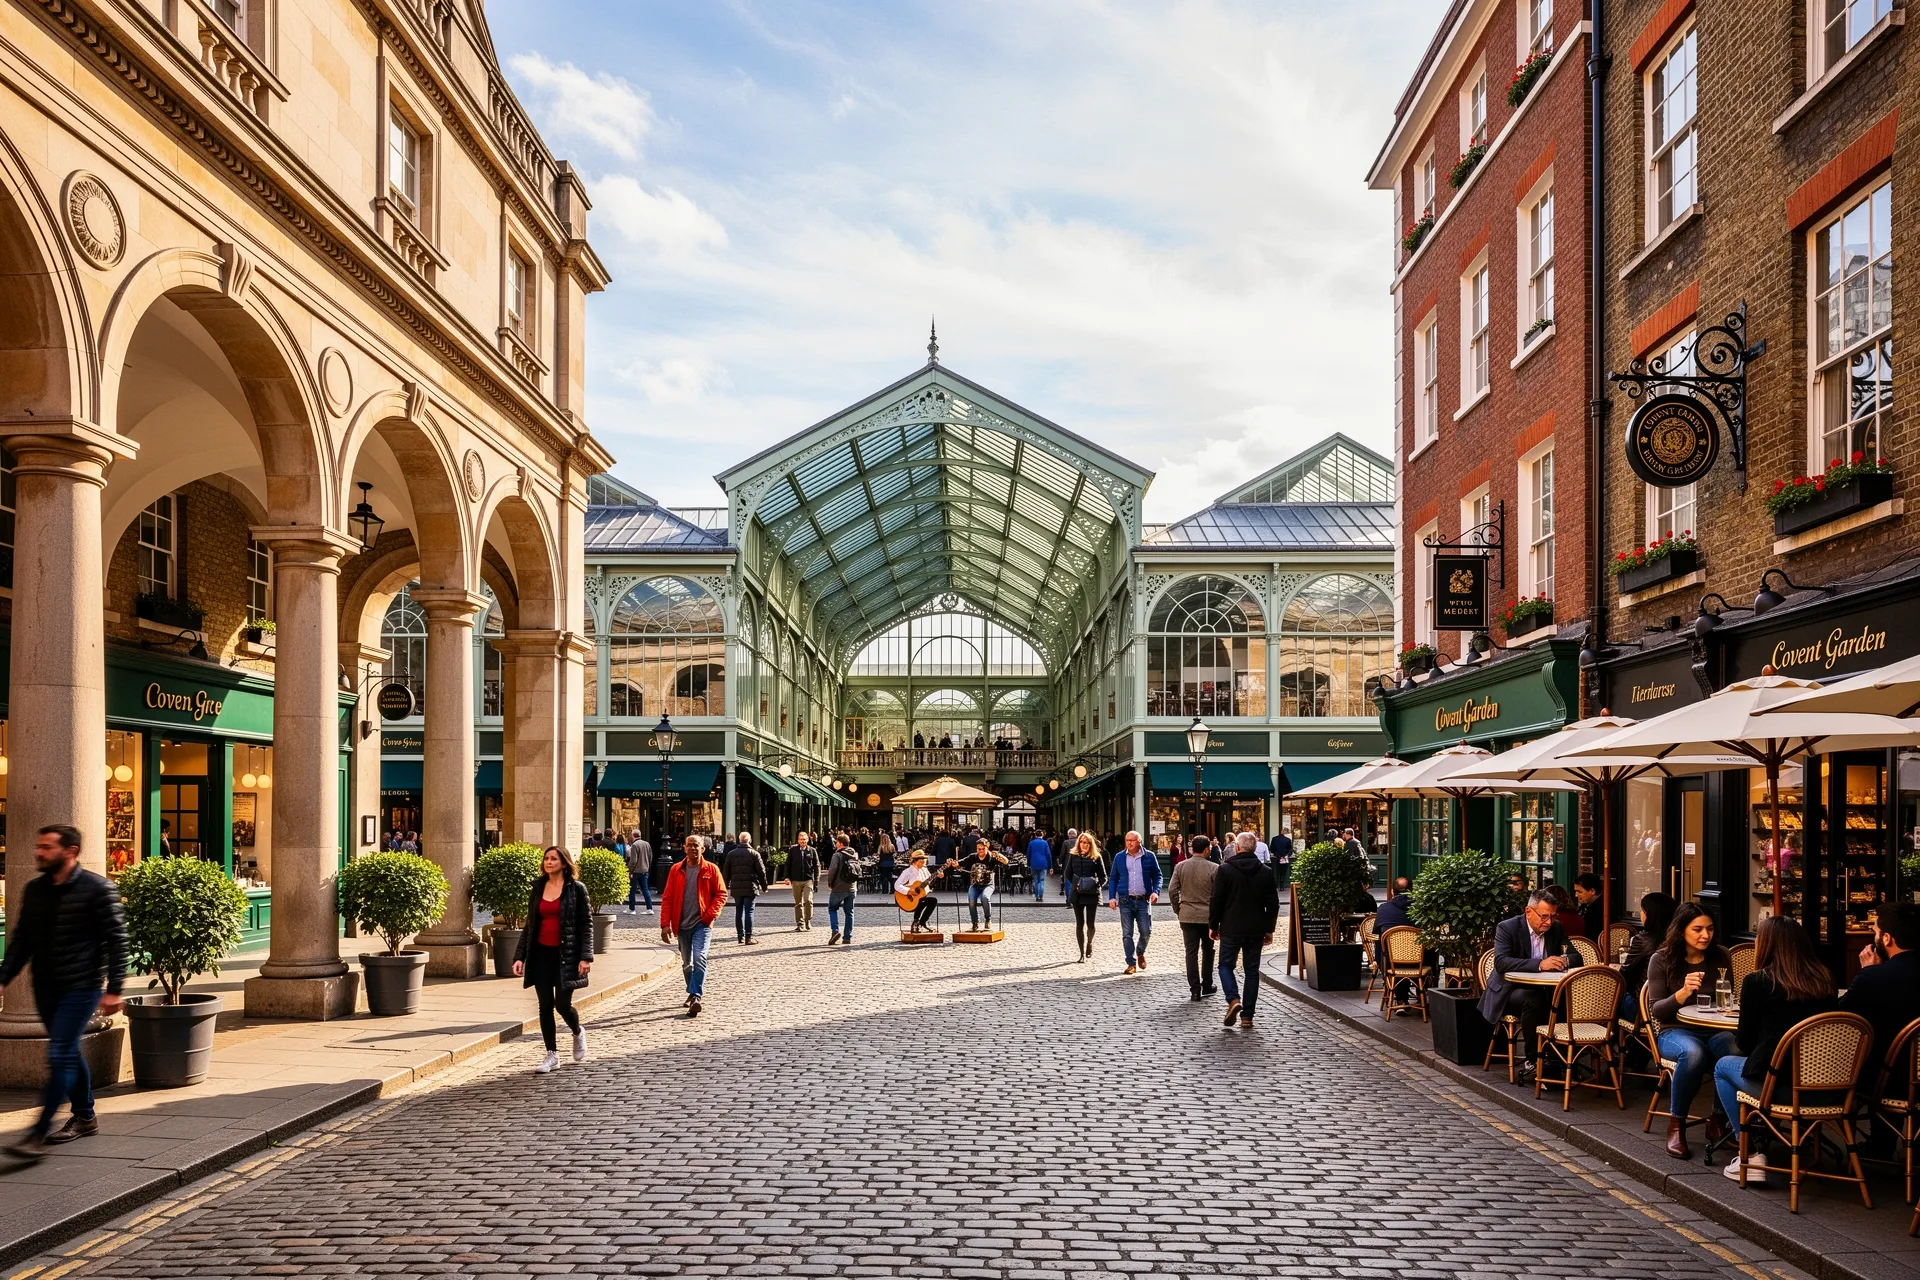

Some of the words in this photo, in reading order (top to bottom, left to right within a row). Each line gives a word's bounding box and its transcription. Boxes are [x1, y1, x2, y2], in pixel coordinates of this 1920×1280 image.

[1772, 640, 1823, 670] Covent
[1825, 625, 1886, 670] Garden
[1463, 695, 1498, 733] Garden
